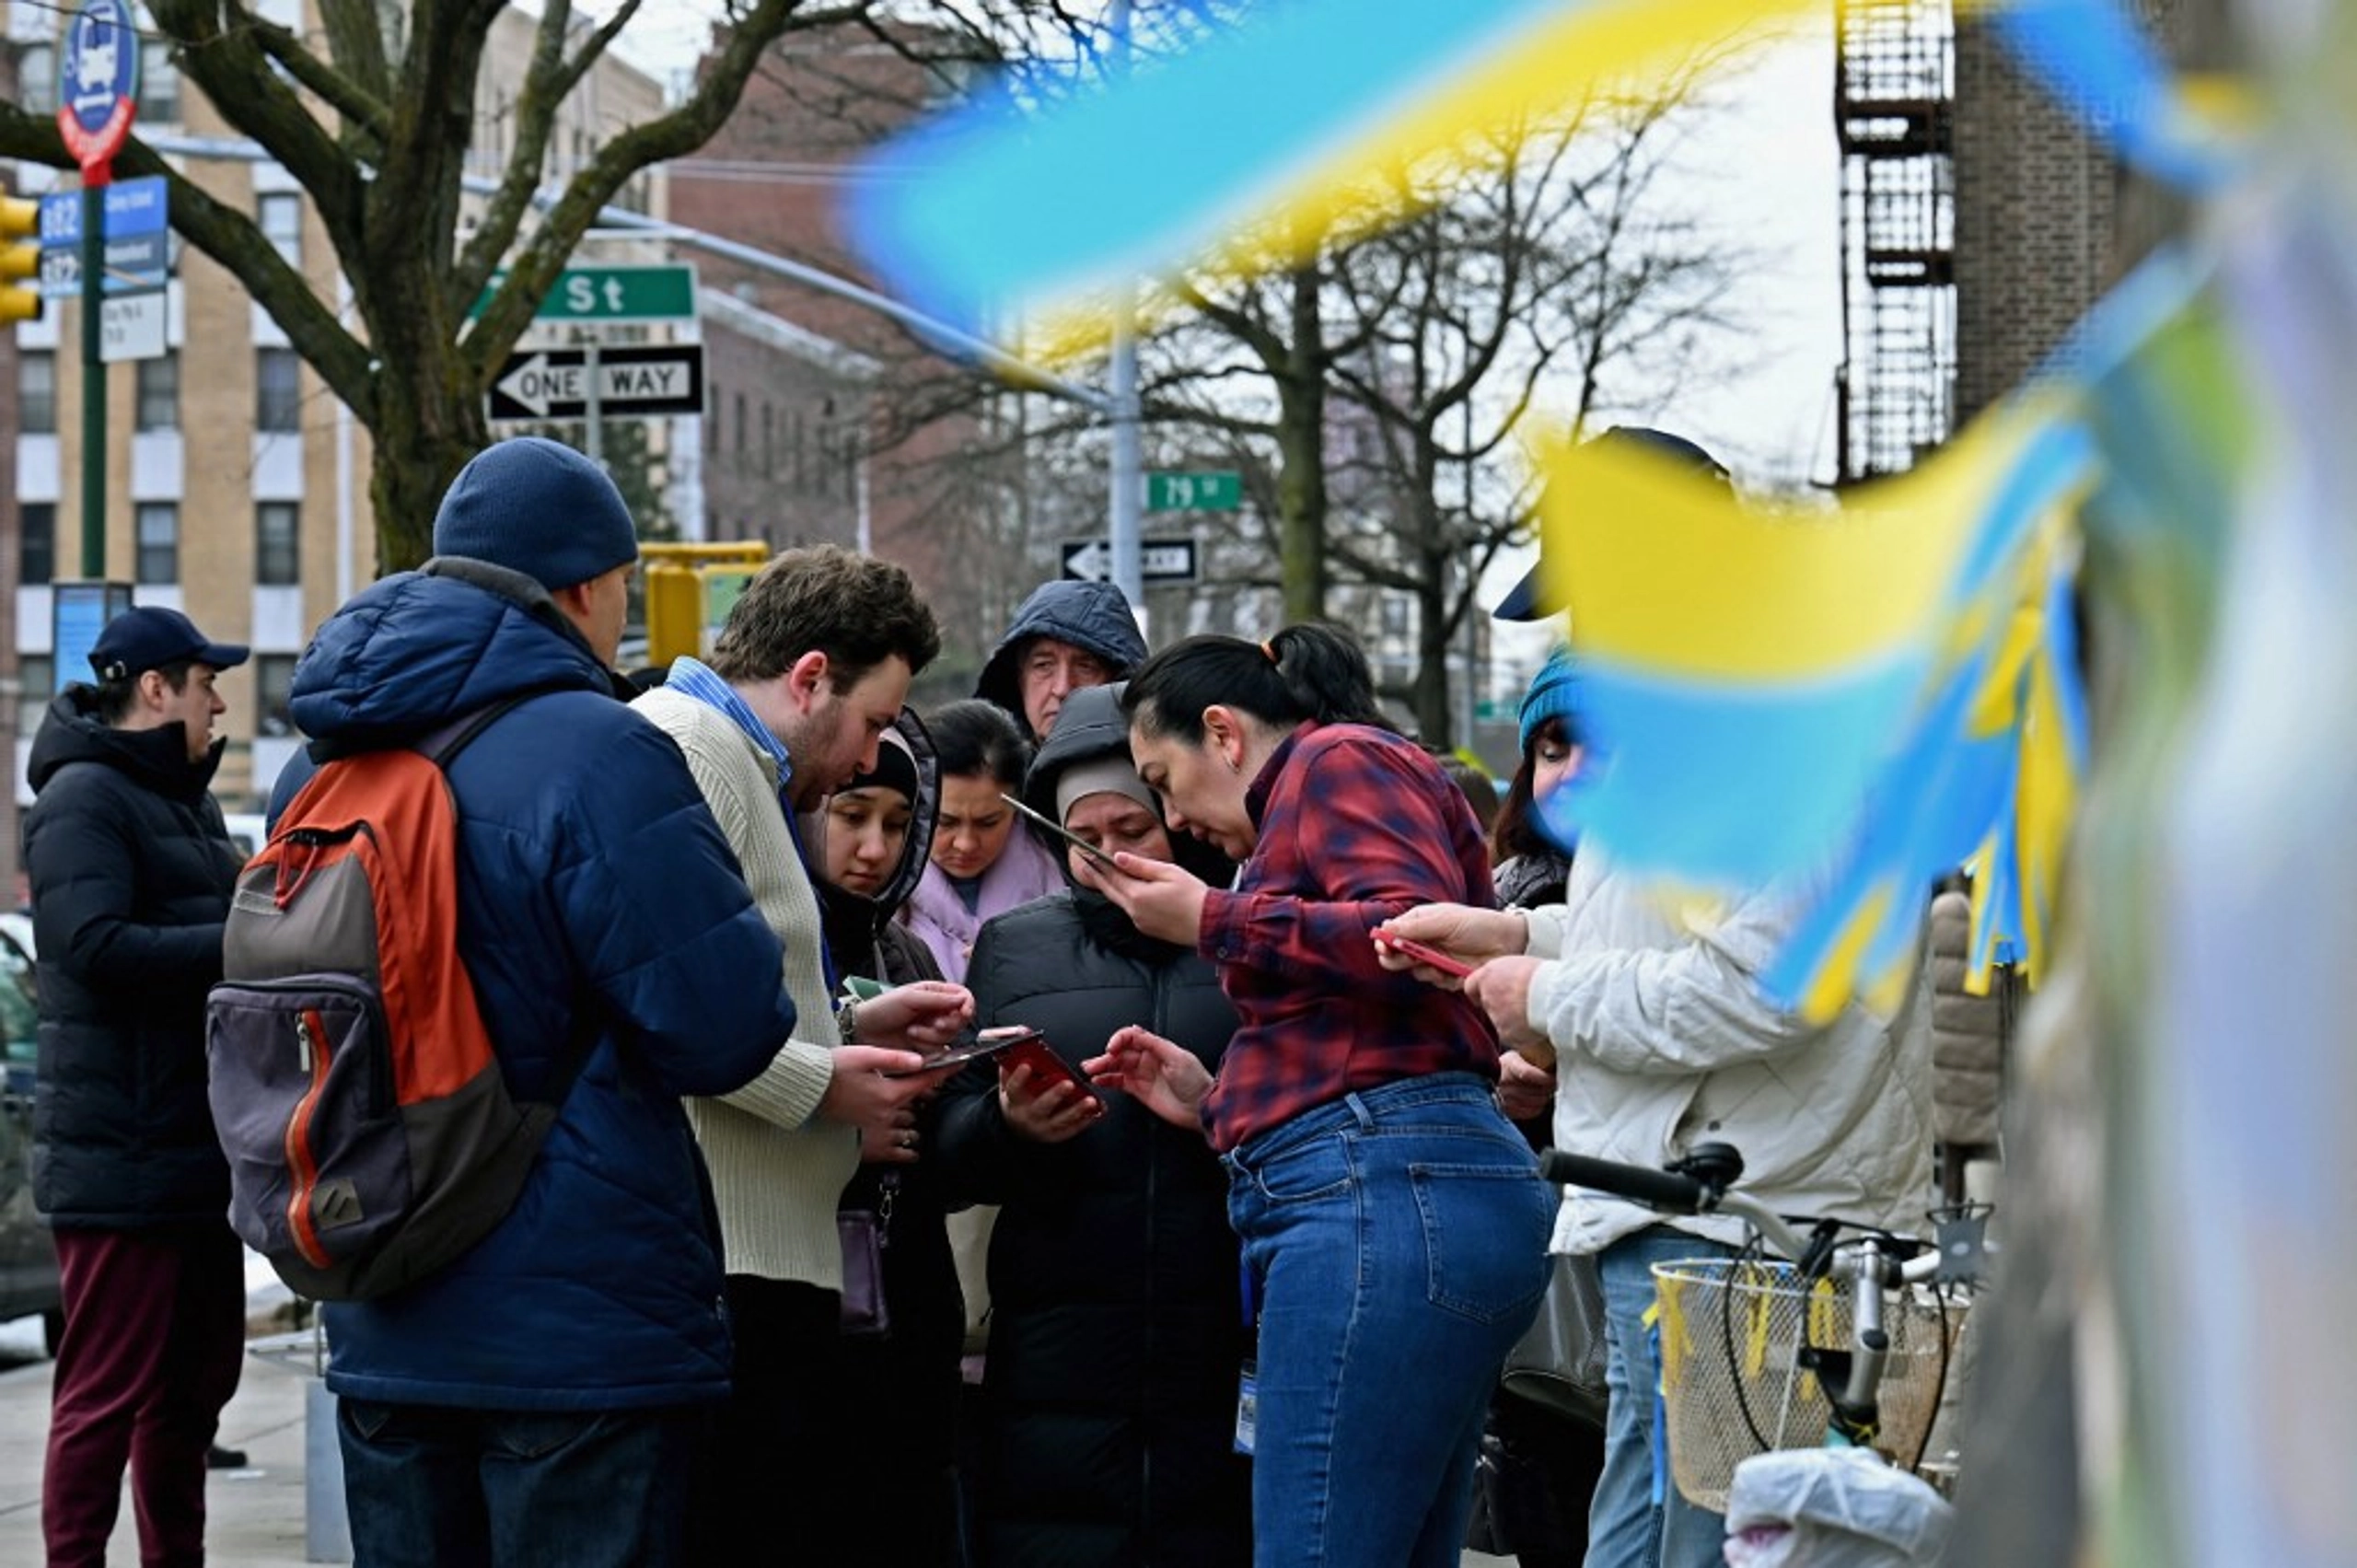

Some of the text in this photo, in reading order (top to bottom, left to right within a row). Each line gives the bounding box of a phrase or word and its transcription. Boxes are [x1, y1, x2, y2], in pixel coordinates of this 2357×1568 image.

[566, 275, 623, 312] St
[520, 366, 674, 399] ONE WAY
